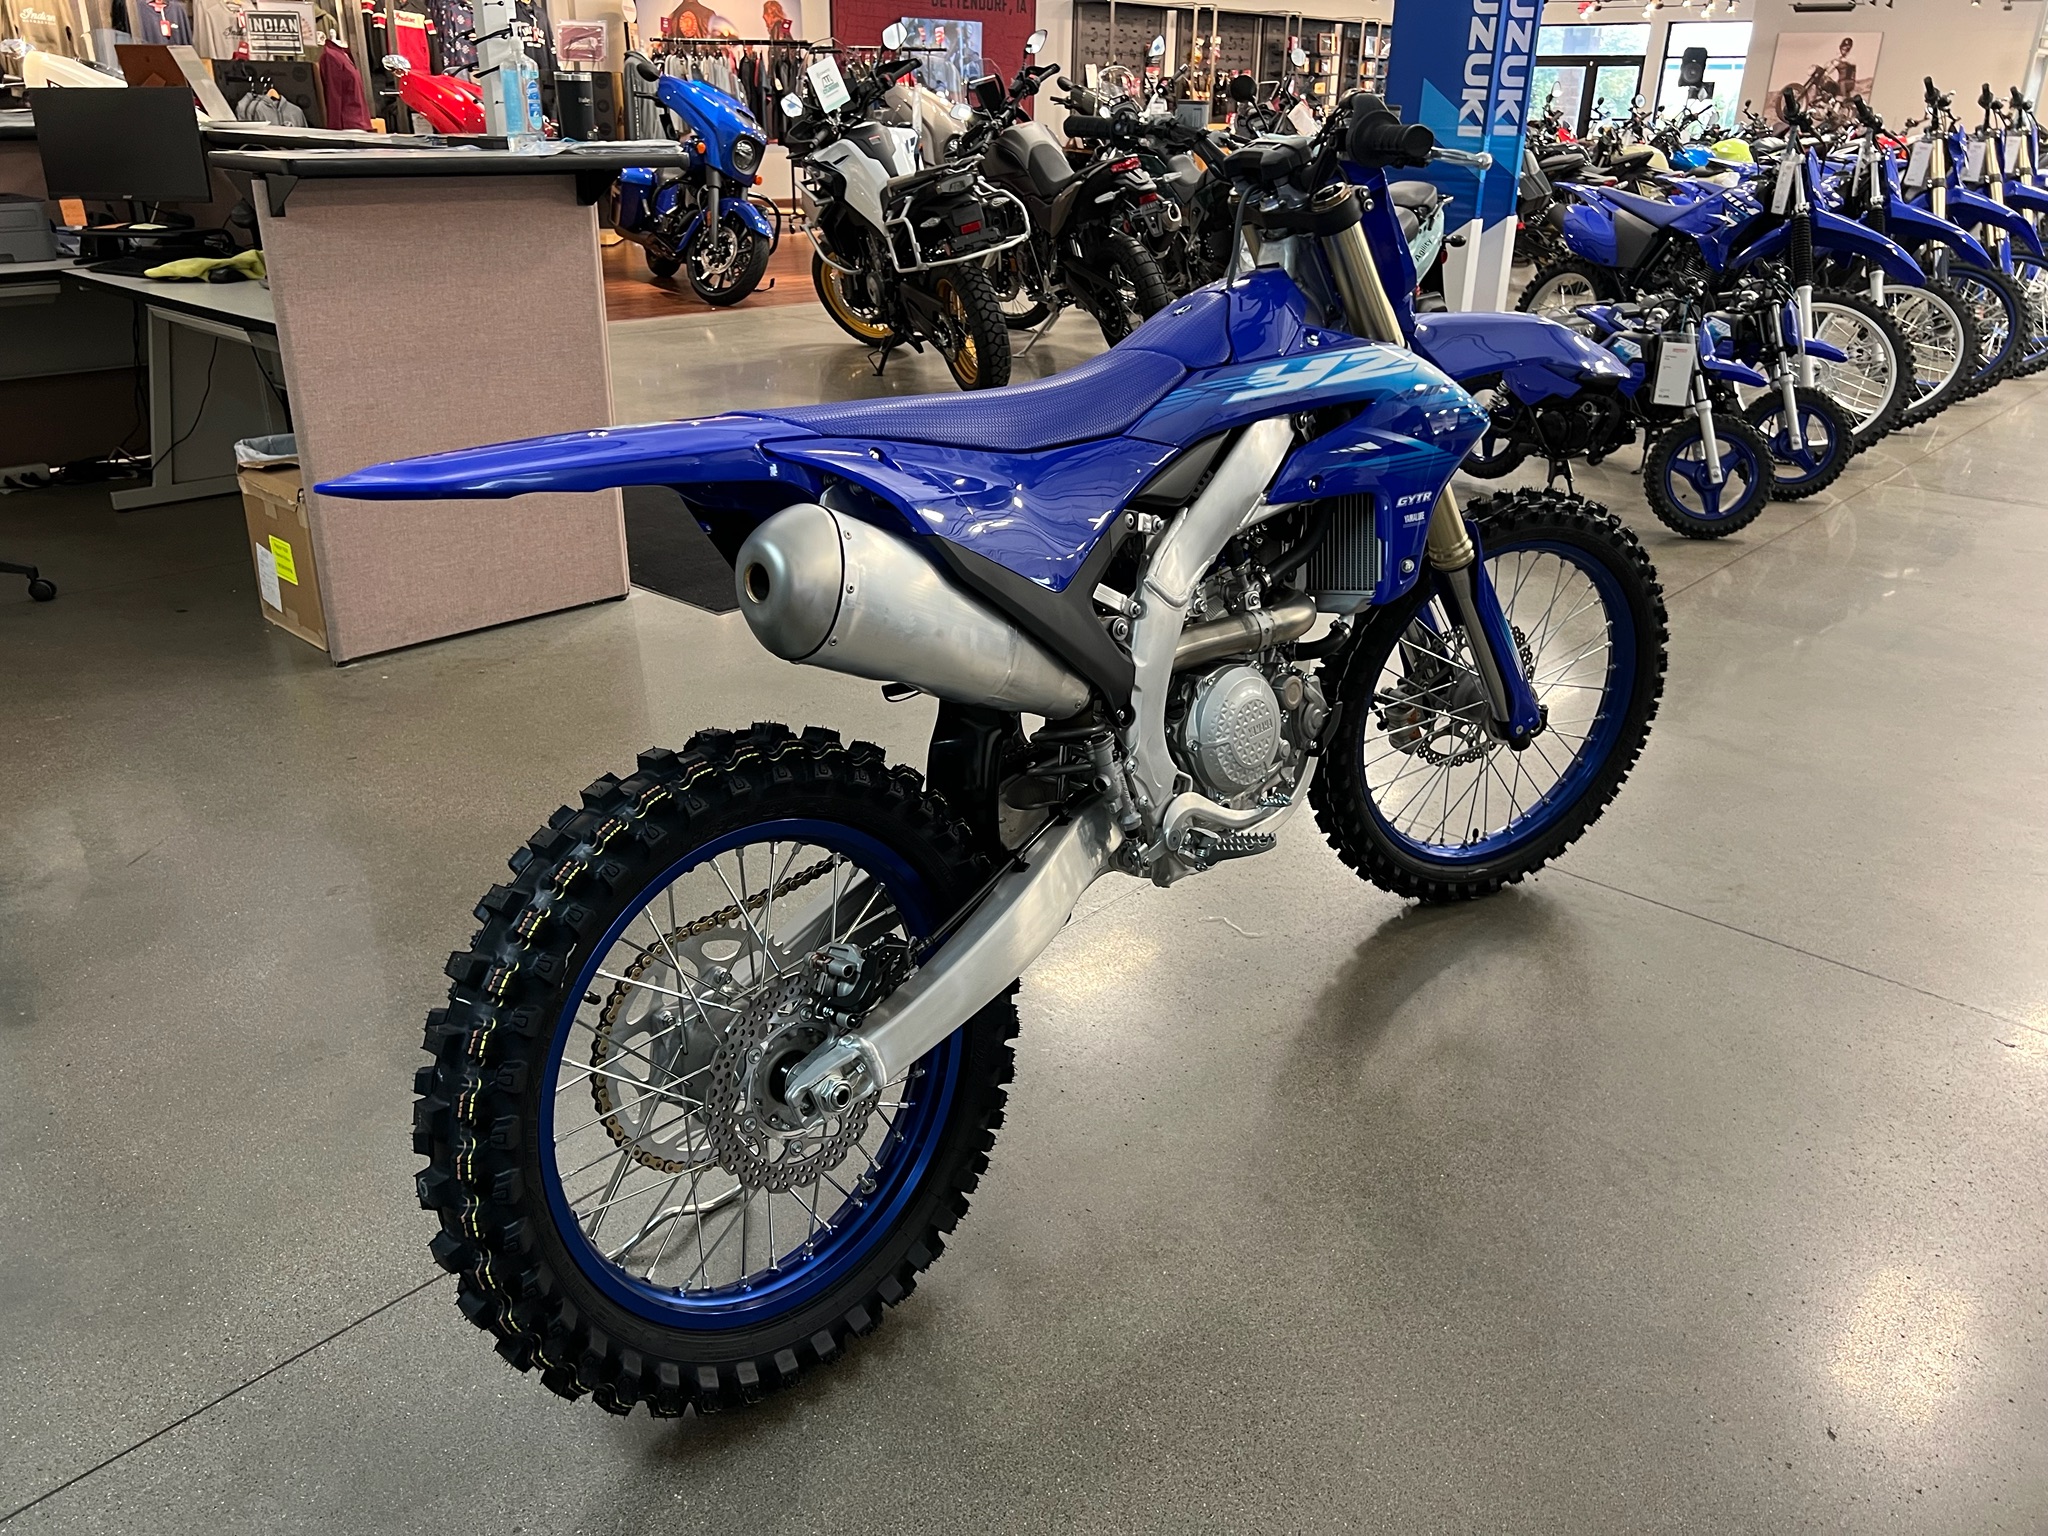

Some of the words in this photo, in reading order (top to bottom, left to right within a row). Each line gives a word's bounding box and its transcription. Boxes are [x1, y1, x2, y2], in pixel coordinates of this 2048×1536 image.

[1016, 0, 1027, 14] IA
[248, 17, 299, 32] INDIAN
[1493, 0, 1535, 136] UZUKI
[1415, 238, 1433, 262] Agility
[1222, 346, 1419, 405] YZ
[1396, 491, 1432, 508] GYTR
[1248, 718, 1274, 739] YAMAHA
